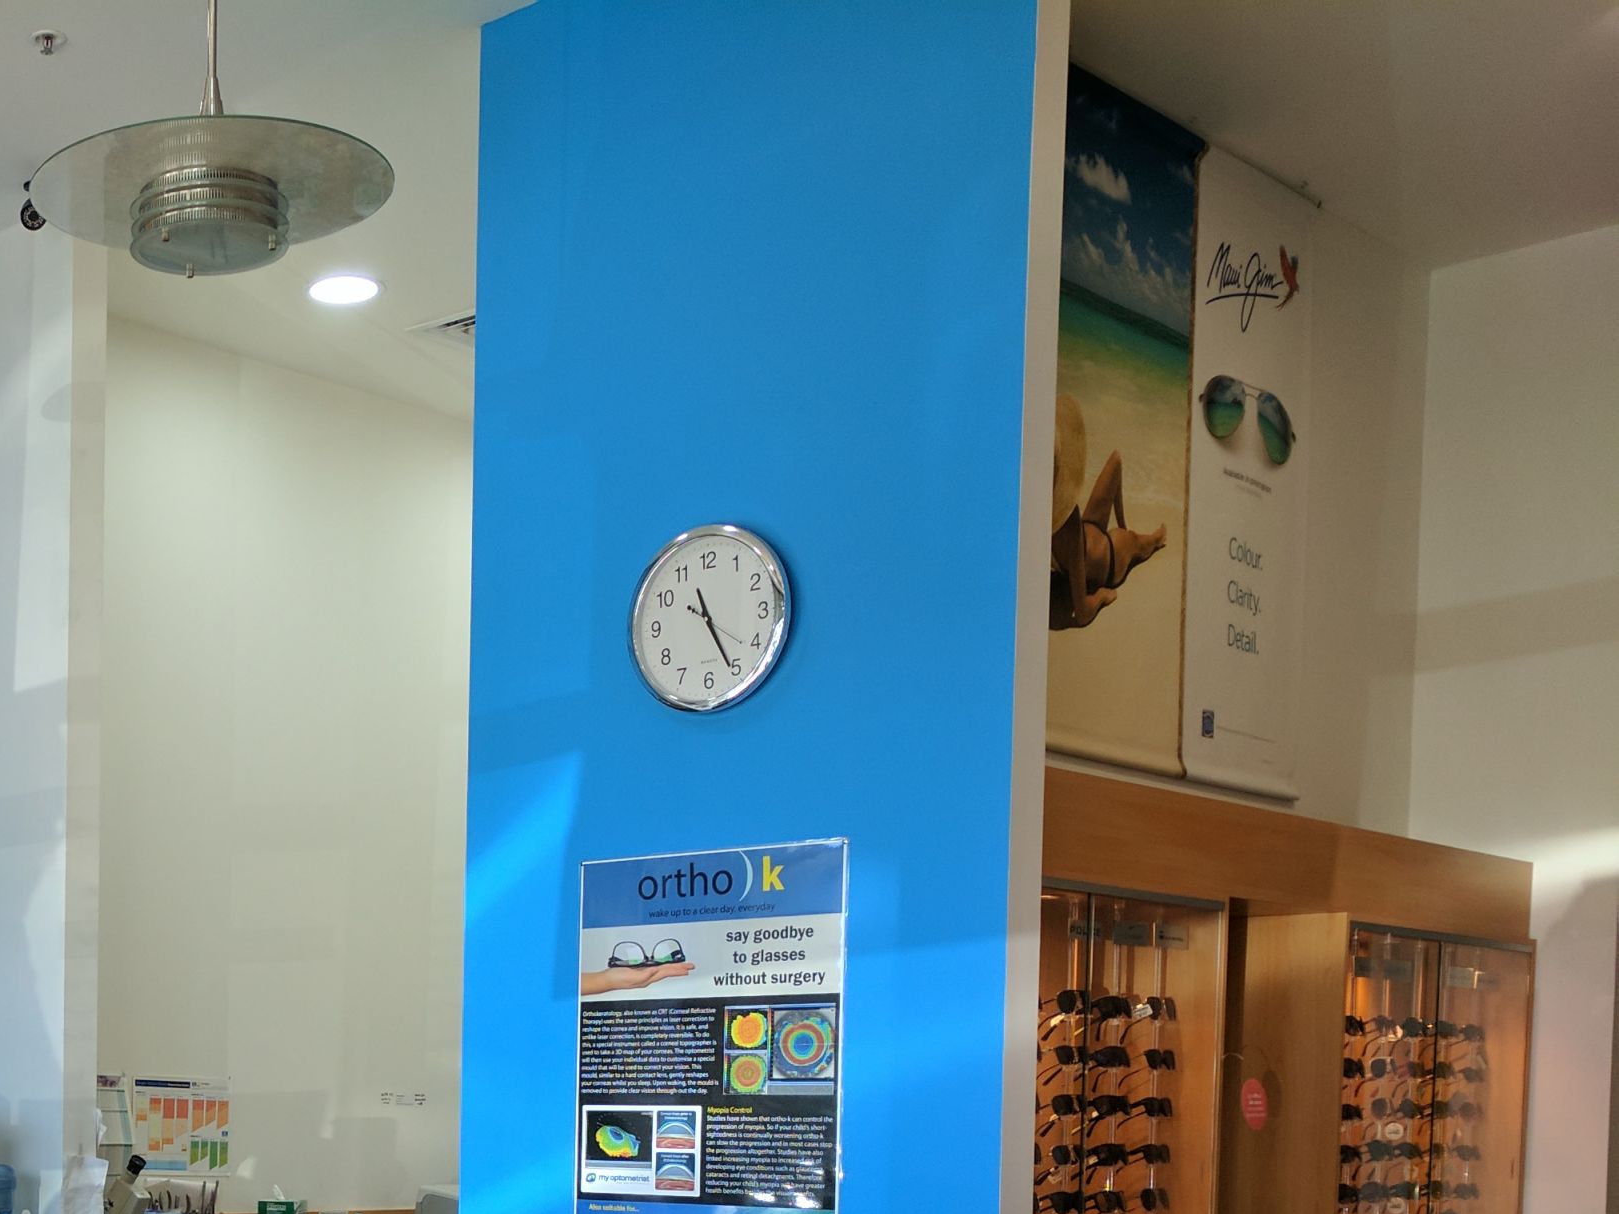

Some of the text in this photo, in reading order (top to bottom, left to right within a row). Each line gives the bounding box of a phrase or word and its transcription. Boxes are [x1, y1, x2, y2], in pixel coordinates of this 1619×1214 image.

[1207, 242, 1284, 332] Maui Jim
[700, 551, 717, 570] 12
[1228, 537, 1263, 571] Colour.
[733, 555, 739, 572] 1
[675, 564, 688, 583] 11
[750, 573, 761, 591] 2
[657, 589, 674, 608] 10
[1227, 580, 1261, 616] Clarity.
[758, 601, 769, 619] 3
[651, 621, 661, 638] 9
[751, 632, 761, 650] 4
[1227, 623, 1260, 655] Detail.
[661, 648, 671, 665] 8
[677, 667, 687, 685] 7
[731, 658, 741, 676] 5
[704, 672, 714, 689] 6
[637, 862, 733, 900] ortho
[649, 909, 669, 918] wake
[670, 909, 681, 918] up
[683, 908, 691, 916] to
[699, 905, 717, 915] clear
[738, 903, 775, 914] everyday
[725, 926, 814, 944] say goodbye
[733, 949, 806, 966] to glasses
[713, 971, 826, 988] without surgery
